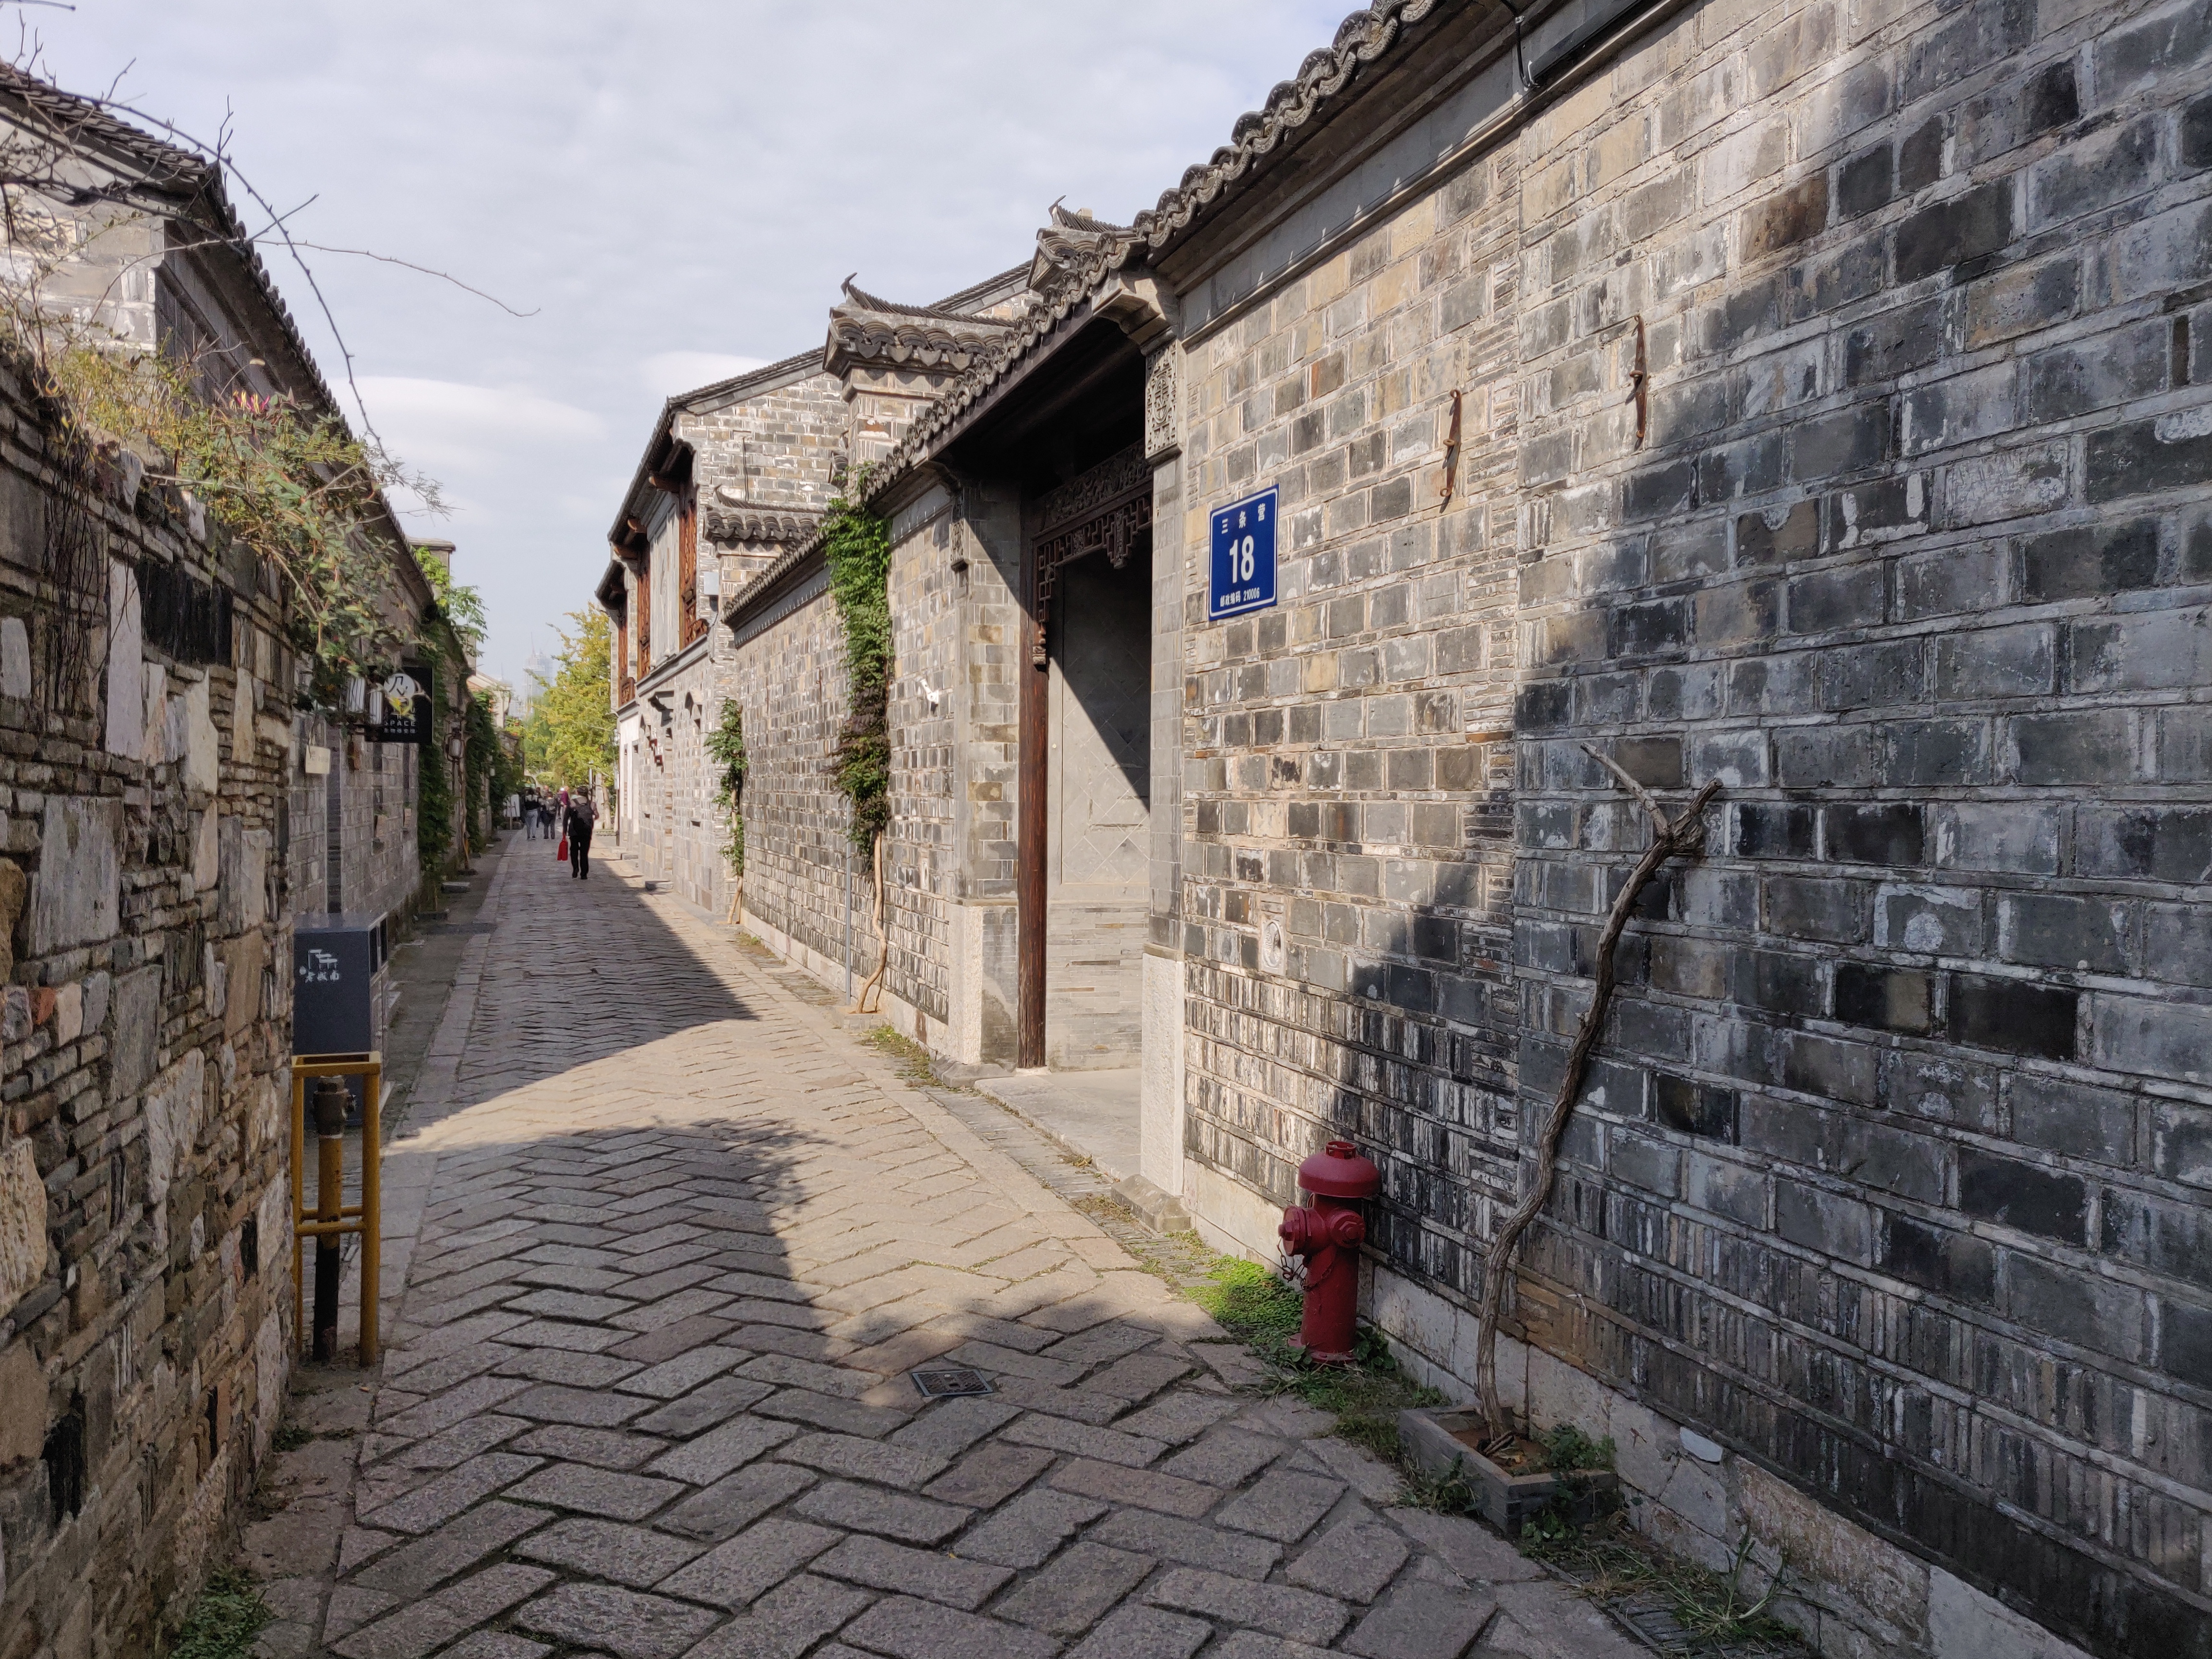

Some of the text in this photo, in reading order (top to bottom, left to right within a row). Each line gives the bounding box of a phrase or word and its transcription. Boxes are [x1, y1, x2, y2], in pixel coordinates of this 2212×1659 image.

[1221, 503, 1265, 534] 三条营
[1229, 535, 1254, 584] 18
[1220, 590, 1240, 607] 邮政编码
[1243, 587, 1260, 602] 210006
